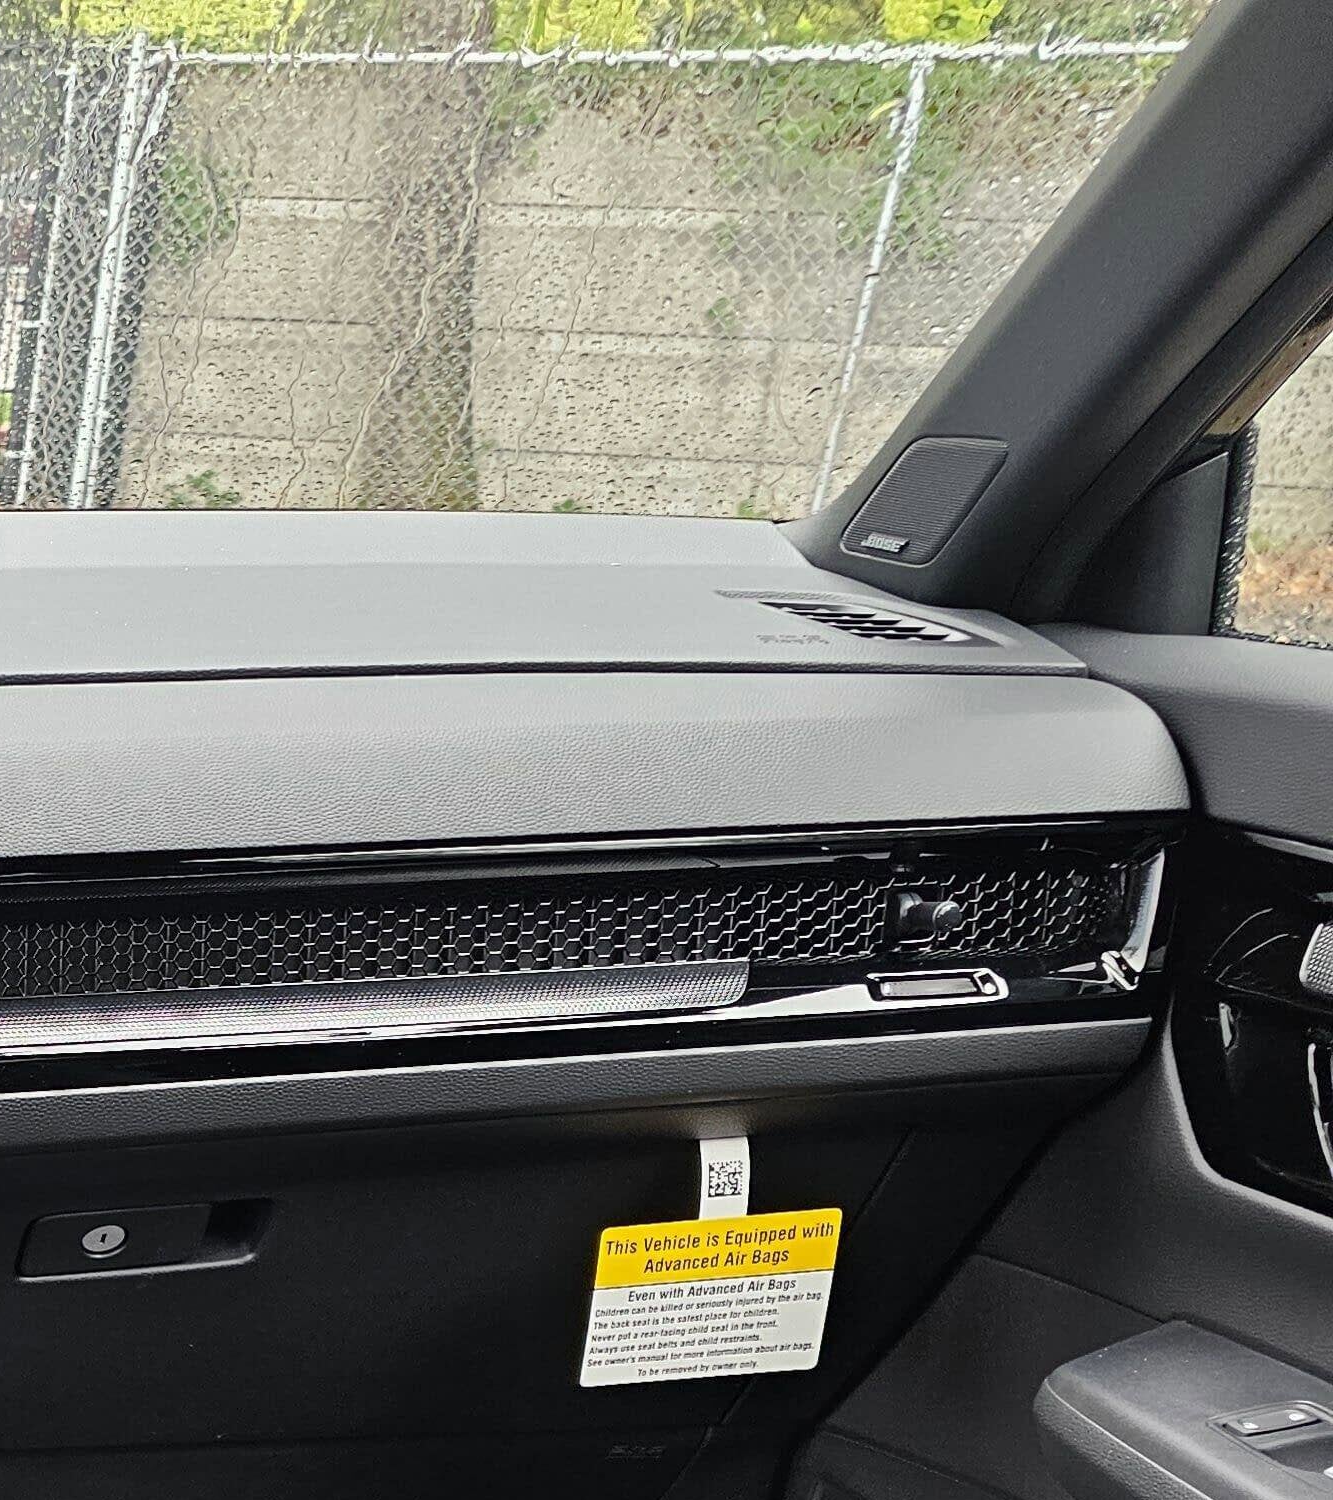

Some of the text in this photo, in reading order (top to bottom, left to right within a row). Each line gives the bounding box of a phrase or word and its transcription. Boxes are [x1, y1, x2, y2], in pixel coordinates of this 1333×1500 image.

[606, 1222, 834, 1256] This Vehicle is Equipped with
[643, 1249, 790, 1274] Advanced Air Bags
[628, 1278, 797, 1303] Even with Advanced Air Bags
[595, 1306, 630, 1318] Children
[631, 1307, 646, 1315] can
[648, 1304, 659, 1313] be
[660, 1302, 683, 1312] killed
[695, 1298, 733, 1310] seriously
[735, 1296, 764, 1307] injured
[766, 1296, 775, 1305] by
[778, 1294, 791, 1302] the
[792, 1293, 804, 1302] air
[806, 1291, 823, 1301] bag.
[591, 1333, 616, 1343] Never
[617, 1332, 631, 1341] put
[640, 1328, 686, 1338] rear-facing
[687, 1325, 709, 1335] child
[710, 1324, 729, 1333] seat
[730, 1323, 739, 1331] in
[741, 1321, 754, 1330] the
[756, 1320, 778, 1329] front.
[593, 1308, 780, 1330] The back seat is the safest place for children.
[587, 1359, 603, 1368] See
[604, 1356, 636, 1366] owner's
[637, 1353, 668, 1363] manual
[670, 1352, 682, 1360] for
[683, 1350, 705, 1358] more
[706, 1346, 753, 1357] information
[754, 1344, 779, 1354] about
[779, 1343, 791, 1352] air
[588, 1346, 618, 1355] Always
[620, 1344, 635, 1352] use
[637, 1342, 656, 1351] seat
[657, 1340, 678, 1350] belts
[679, 1338, 696, 1348] and
[697, 1336, 719, 1346] child
[637, 1368, 647, 1377] To
[649, 1367, 660, 1376] be
[661, 1364, 697, 1375] removed
[700, 1364, 710, 1372] by
[711, 1362, 737, 1371] owner
